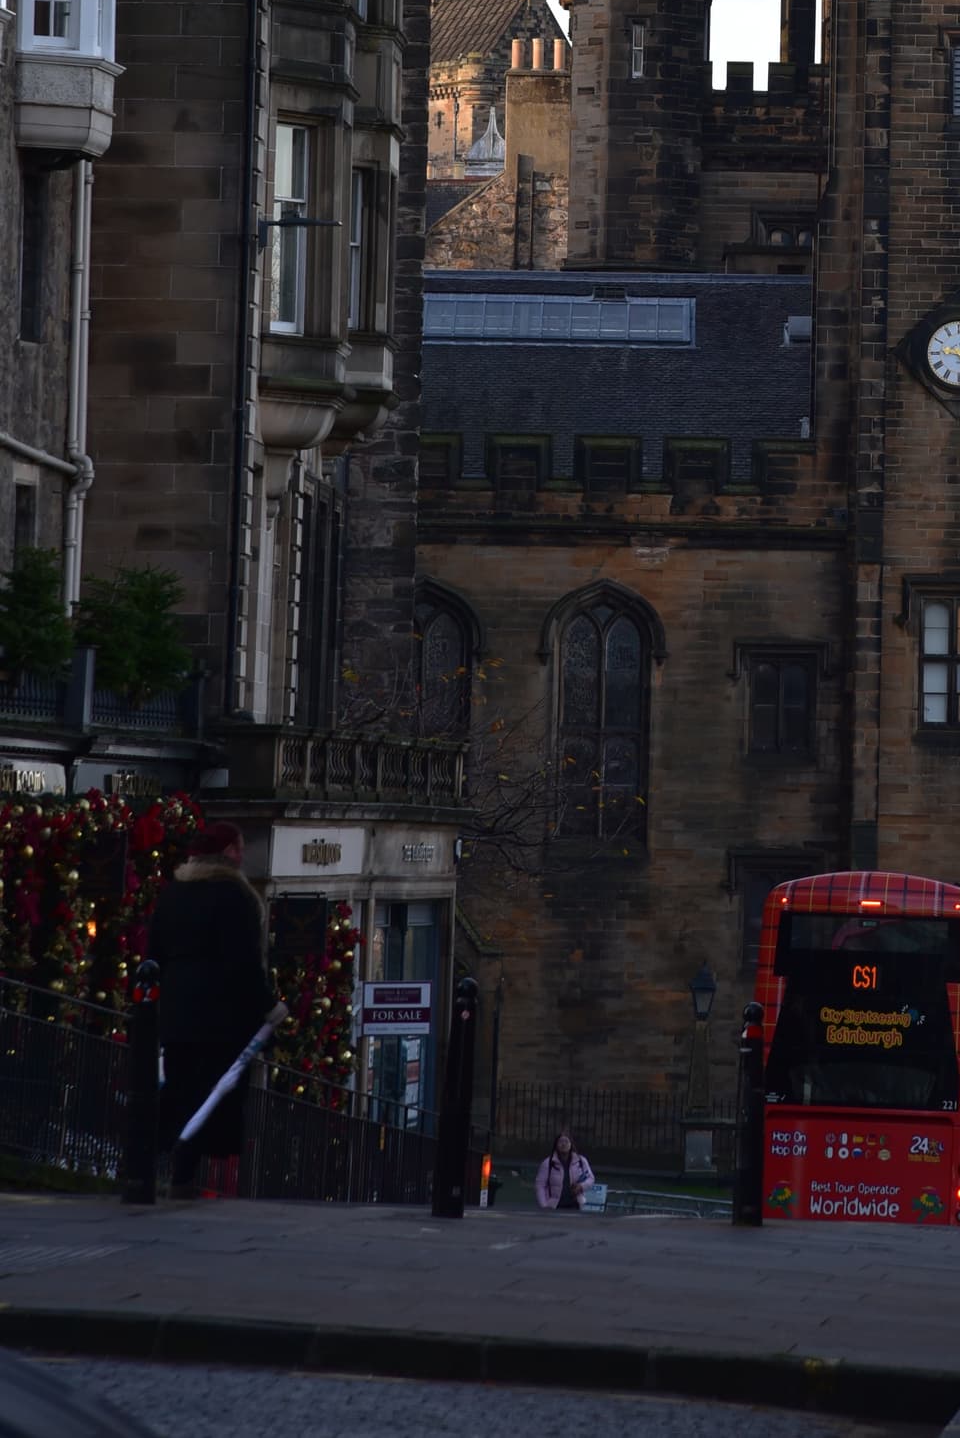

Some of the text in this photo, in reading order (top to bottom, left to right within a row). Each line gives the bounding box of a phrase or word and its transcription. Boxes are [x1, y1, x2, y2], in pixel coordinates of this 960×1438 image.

[852, 965, 877, 989] CS1
[372, 1010, 422, 1020] FOR SALE
[821, 1007, 912, 1027] City Sightseeing
[827, 1026, 903, 1049] Edinburgh
[942, 1100, 957, 1111] 221
[772, 1131, 807, 1143] Hop On
[910, 1136, 929, 1154] 24
[772, 1144, 808, 1157] Hop Off
[811, 1180, 901, 1197] Best Tour Operator
[810, 1195, 900, 1218] Worldwide
